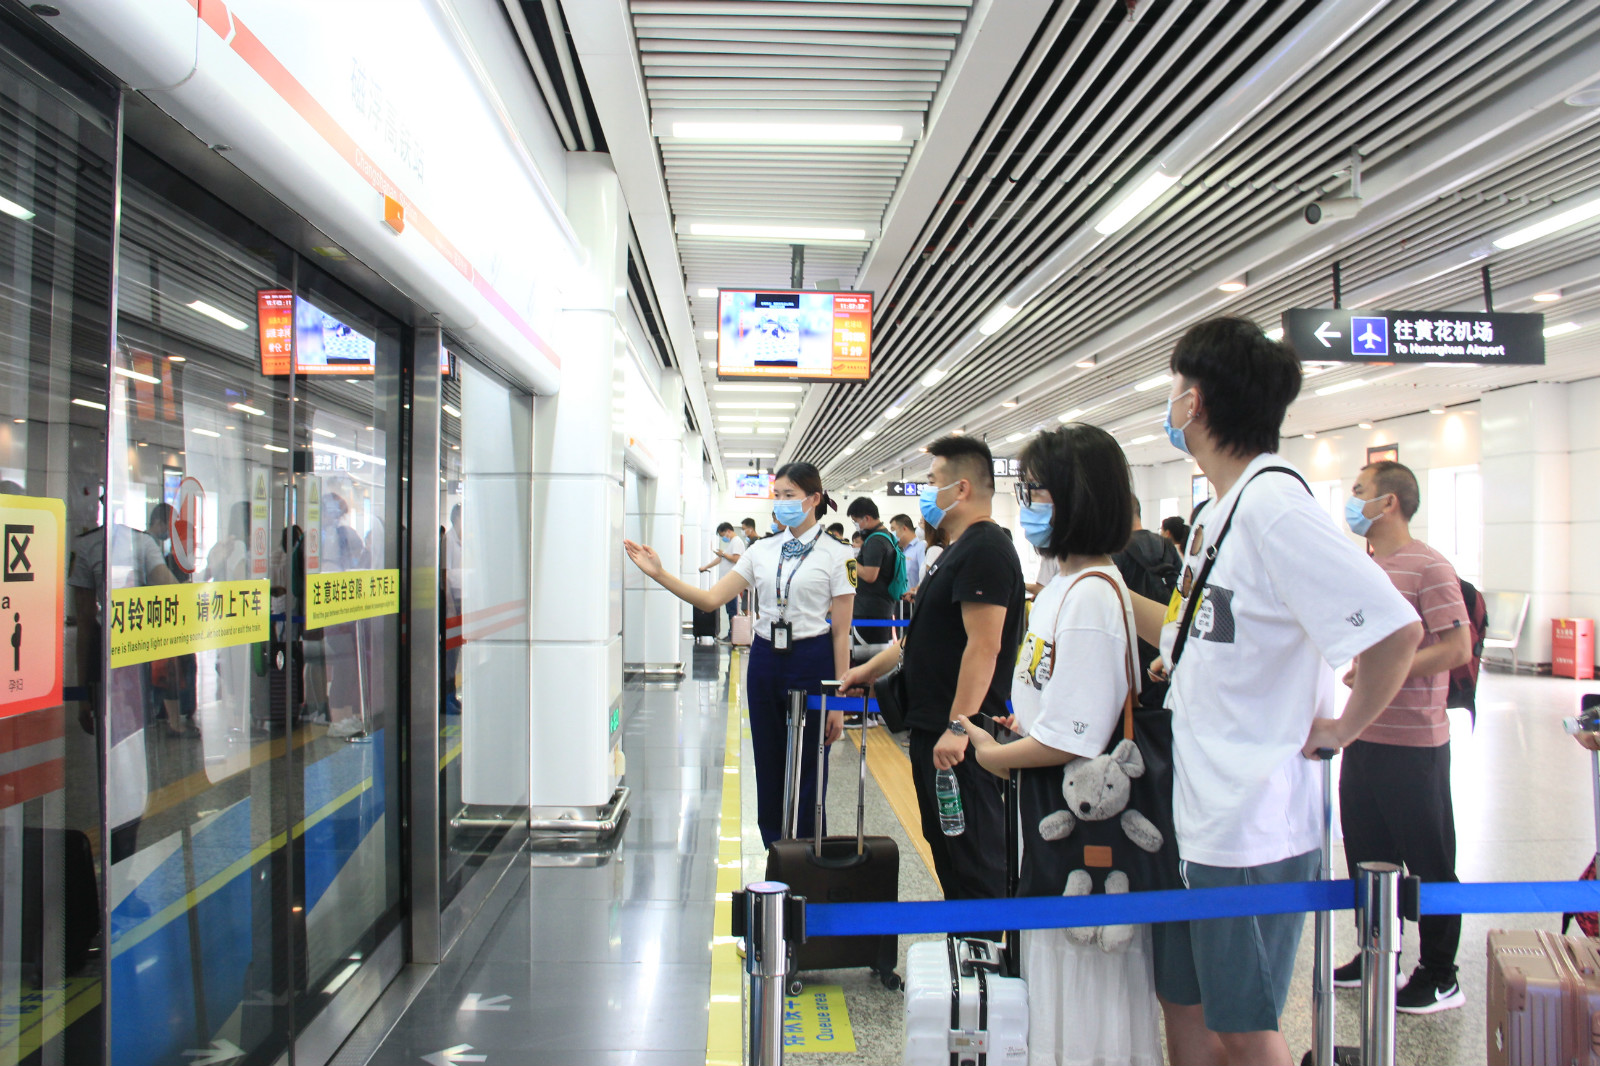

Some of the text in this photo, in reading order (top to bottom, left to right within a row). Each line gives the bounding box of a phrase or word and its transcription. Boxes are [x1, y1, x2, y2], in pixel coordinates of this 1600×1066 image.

[350, 56, 425, 185] 磁浮高铁站
[1393, 319, 1493, 342] 往黄花机场
[1393, 343, 1505, 357] To Huanghua Airport
[3, 524, 35, 582] 区
[313, 575, 395, 605] 注意站台空隙，先下后上
[121, 642, 127, 654] is
[128, 639, 150, 651] flashing
[150, 637, 163, 650] light
[163, 638, 169, 646] or
[169, 633, 190, 645] warning
[8, 679, 24, 692] 孕妇
[814, 993, 835, 1041] Queue area
